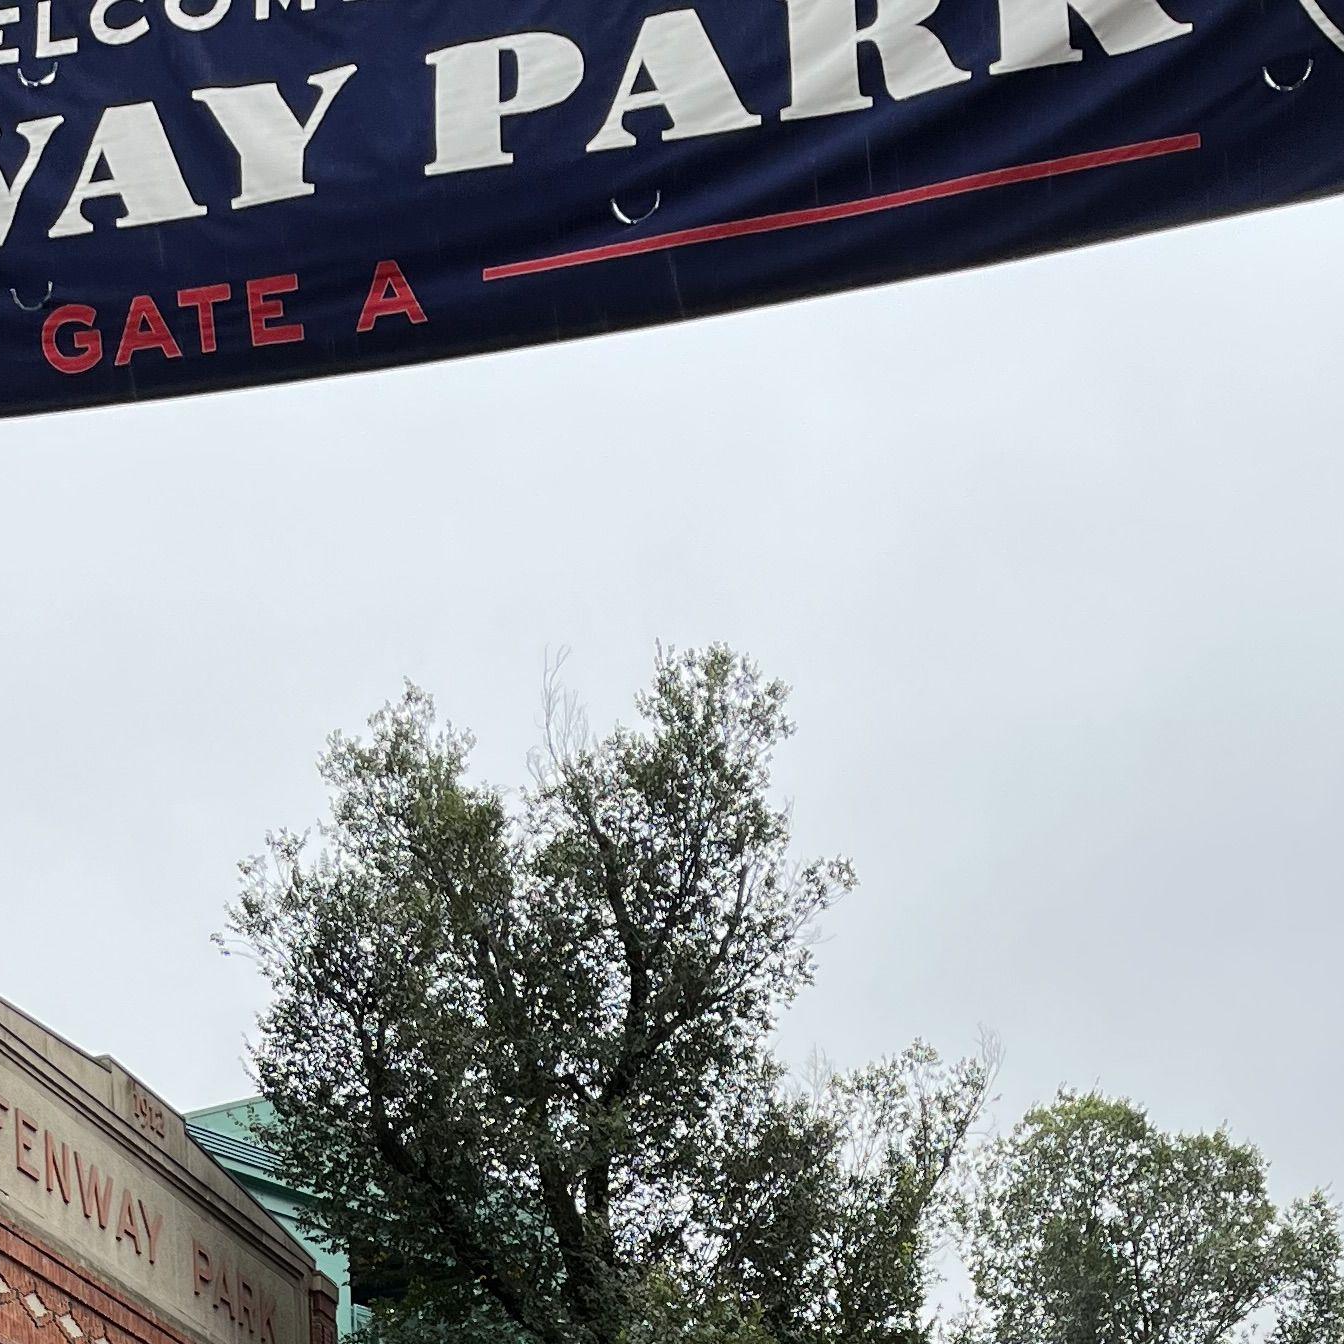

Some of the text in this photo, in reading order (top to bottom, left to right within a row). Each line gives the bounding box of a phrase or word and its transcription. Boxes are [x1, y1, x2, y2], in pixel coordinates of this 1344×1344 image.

[40, 258, 429, 376] GATE A
[131, 1090, 166, 1139] 1912
